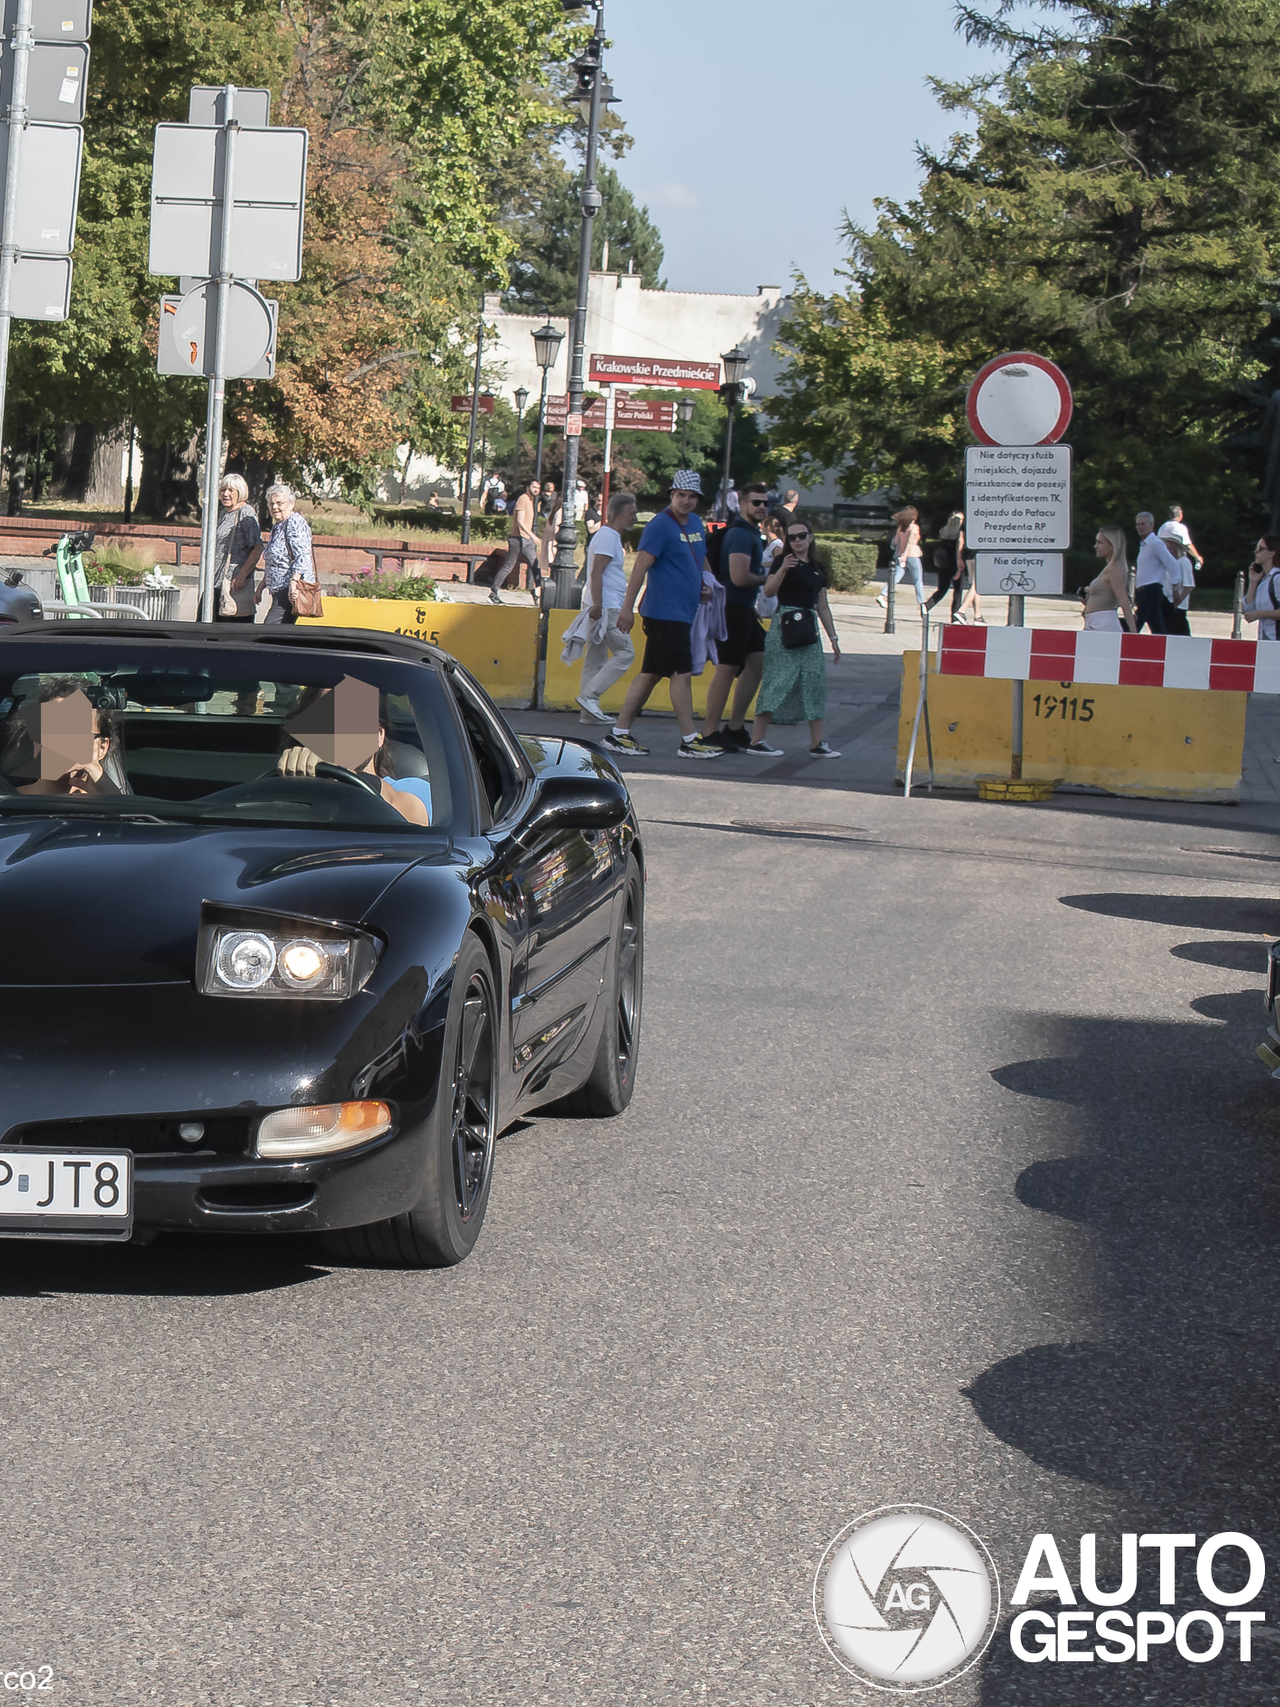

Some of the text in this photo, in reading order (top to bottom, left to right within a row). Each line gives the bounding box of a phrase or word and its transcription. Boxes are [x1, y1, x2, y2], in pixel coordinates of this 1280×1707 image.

[596, 360, 714, 380] Krakowskie Przedmieście
[979, 450, 1054, 461] Nie dotyczy służb
[974, 466, 1057, 476] miejskich, dojazdu
[1037, 480, 1066, 489] posesji
[977, 494, 1048, 504] identyfikatorem
[974, 509, 1009, 518] dojazdu
[984, 522, 1033, 532] Prezydenta
[1011, 557, 1044, 567] dotyczy
[1032, 694, 1095, 722] 19115
[36, 1160, 120, 1208] JT8
